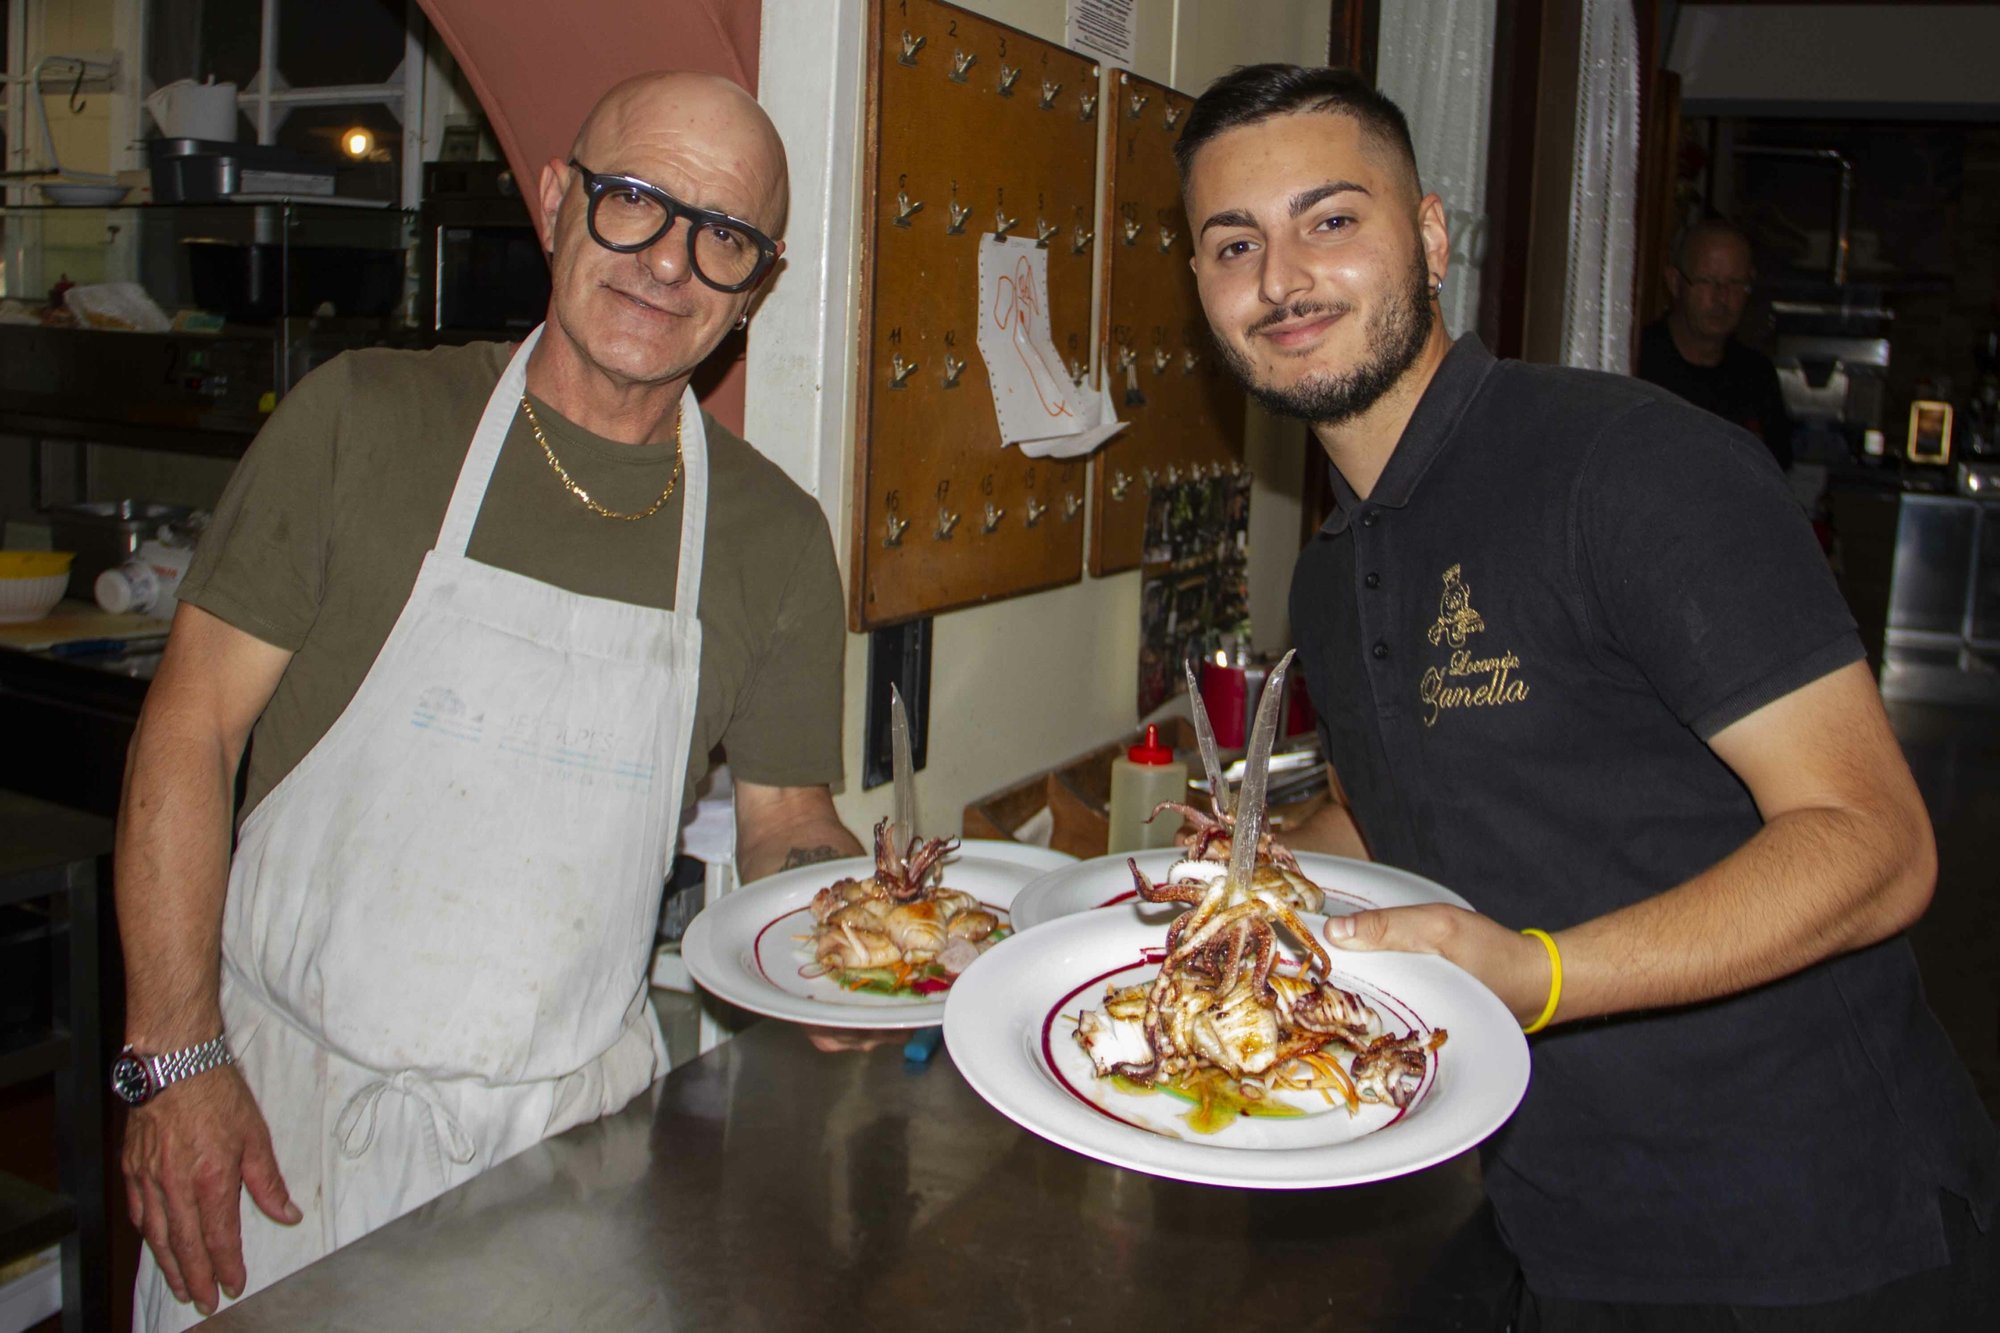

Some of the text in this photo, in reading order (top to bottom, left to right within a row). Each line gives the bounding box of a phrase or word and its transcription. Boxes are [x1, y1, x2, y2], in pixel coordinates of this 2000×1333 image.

[948, 19, 958, 38] 2
[998, 36, 1007, 58] 3
[888, 326, 903, 346] 11
[884, 488, 899, 512] 16
[935, 479, 950, 504] 17
[1449, 649, 1520, 676] Locanda
